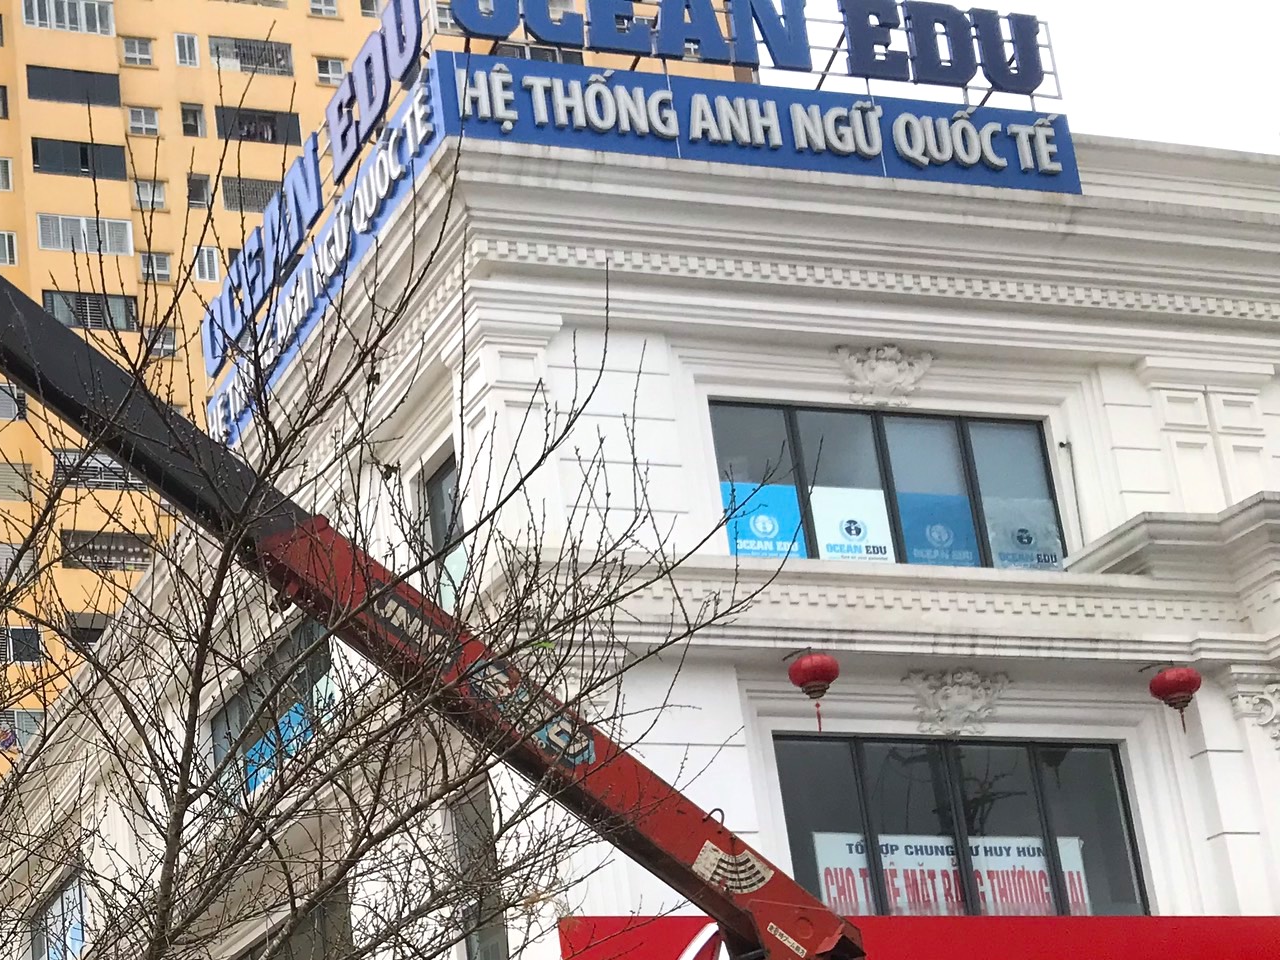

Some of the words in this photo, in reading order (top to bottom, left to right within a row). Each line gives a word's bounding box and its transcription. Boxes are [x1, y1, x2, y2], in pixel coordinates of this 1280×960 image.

[325, 0, 423, 186] EDU
[837, 0, 1045, 95] EDU
[455, 62, 519, 134] HỆ
[521, 69, 680, 138] THỐNG
[689, 92, 783, 148] ANH
[789, 100, 883, 160] NGỮ
[892, 105, 1008, 170] QUỐC
[1007, 113, 1064, 175] TẾ
[826, 543, 863, 554] OCEAN
[865, 545, 887, 555] EDU
[904, 844, 956, 857] CHUNG
[983, 845, 1012, 857] HUY
[1016, 844, 1045, 857] HÙN
